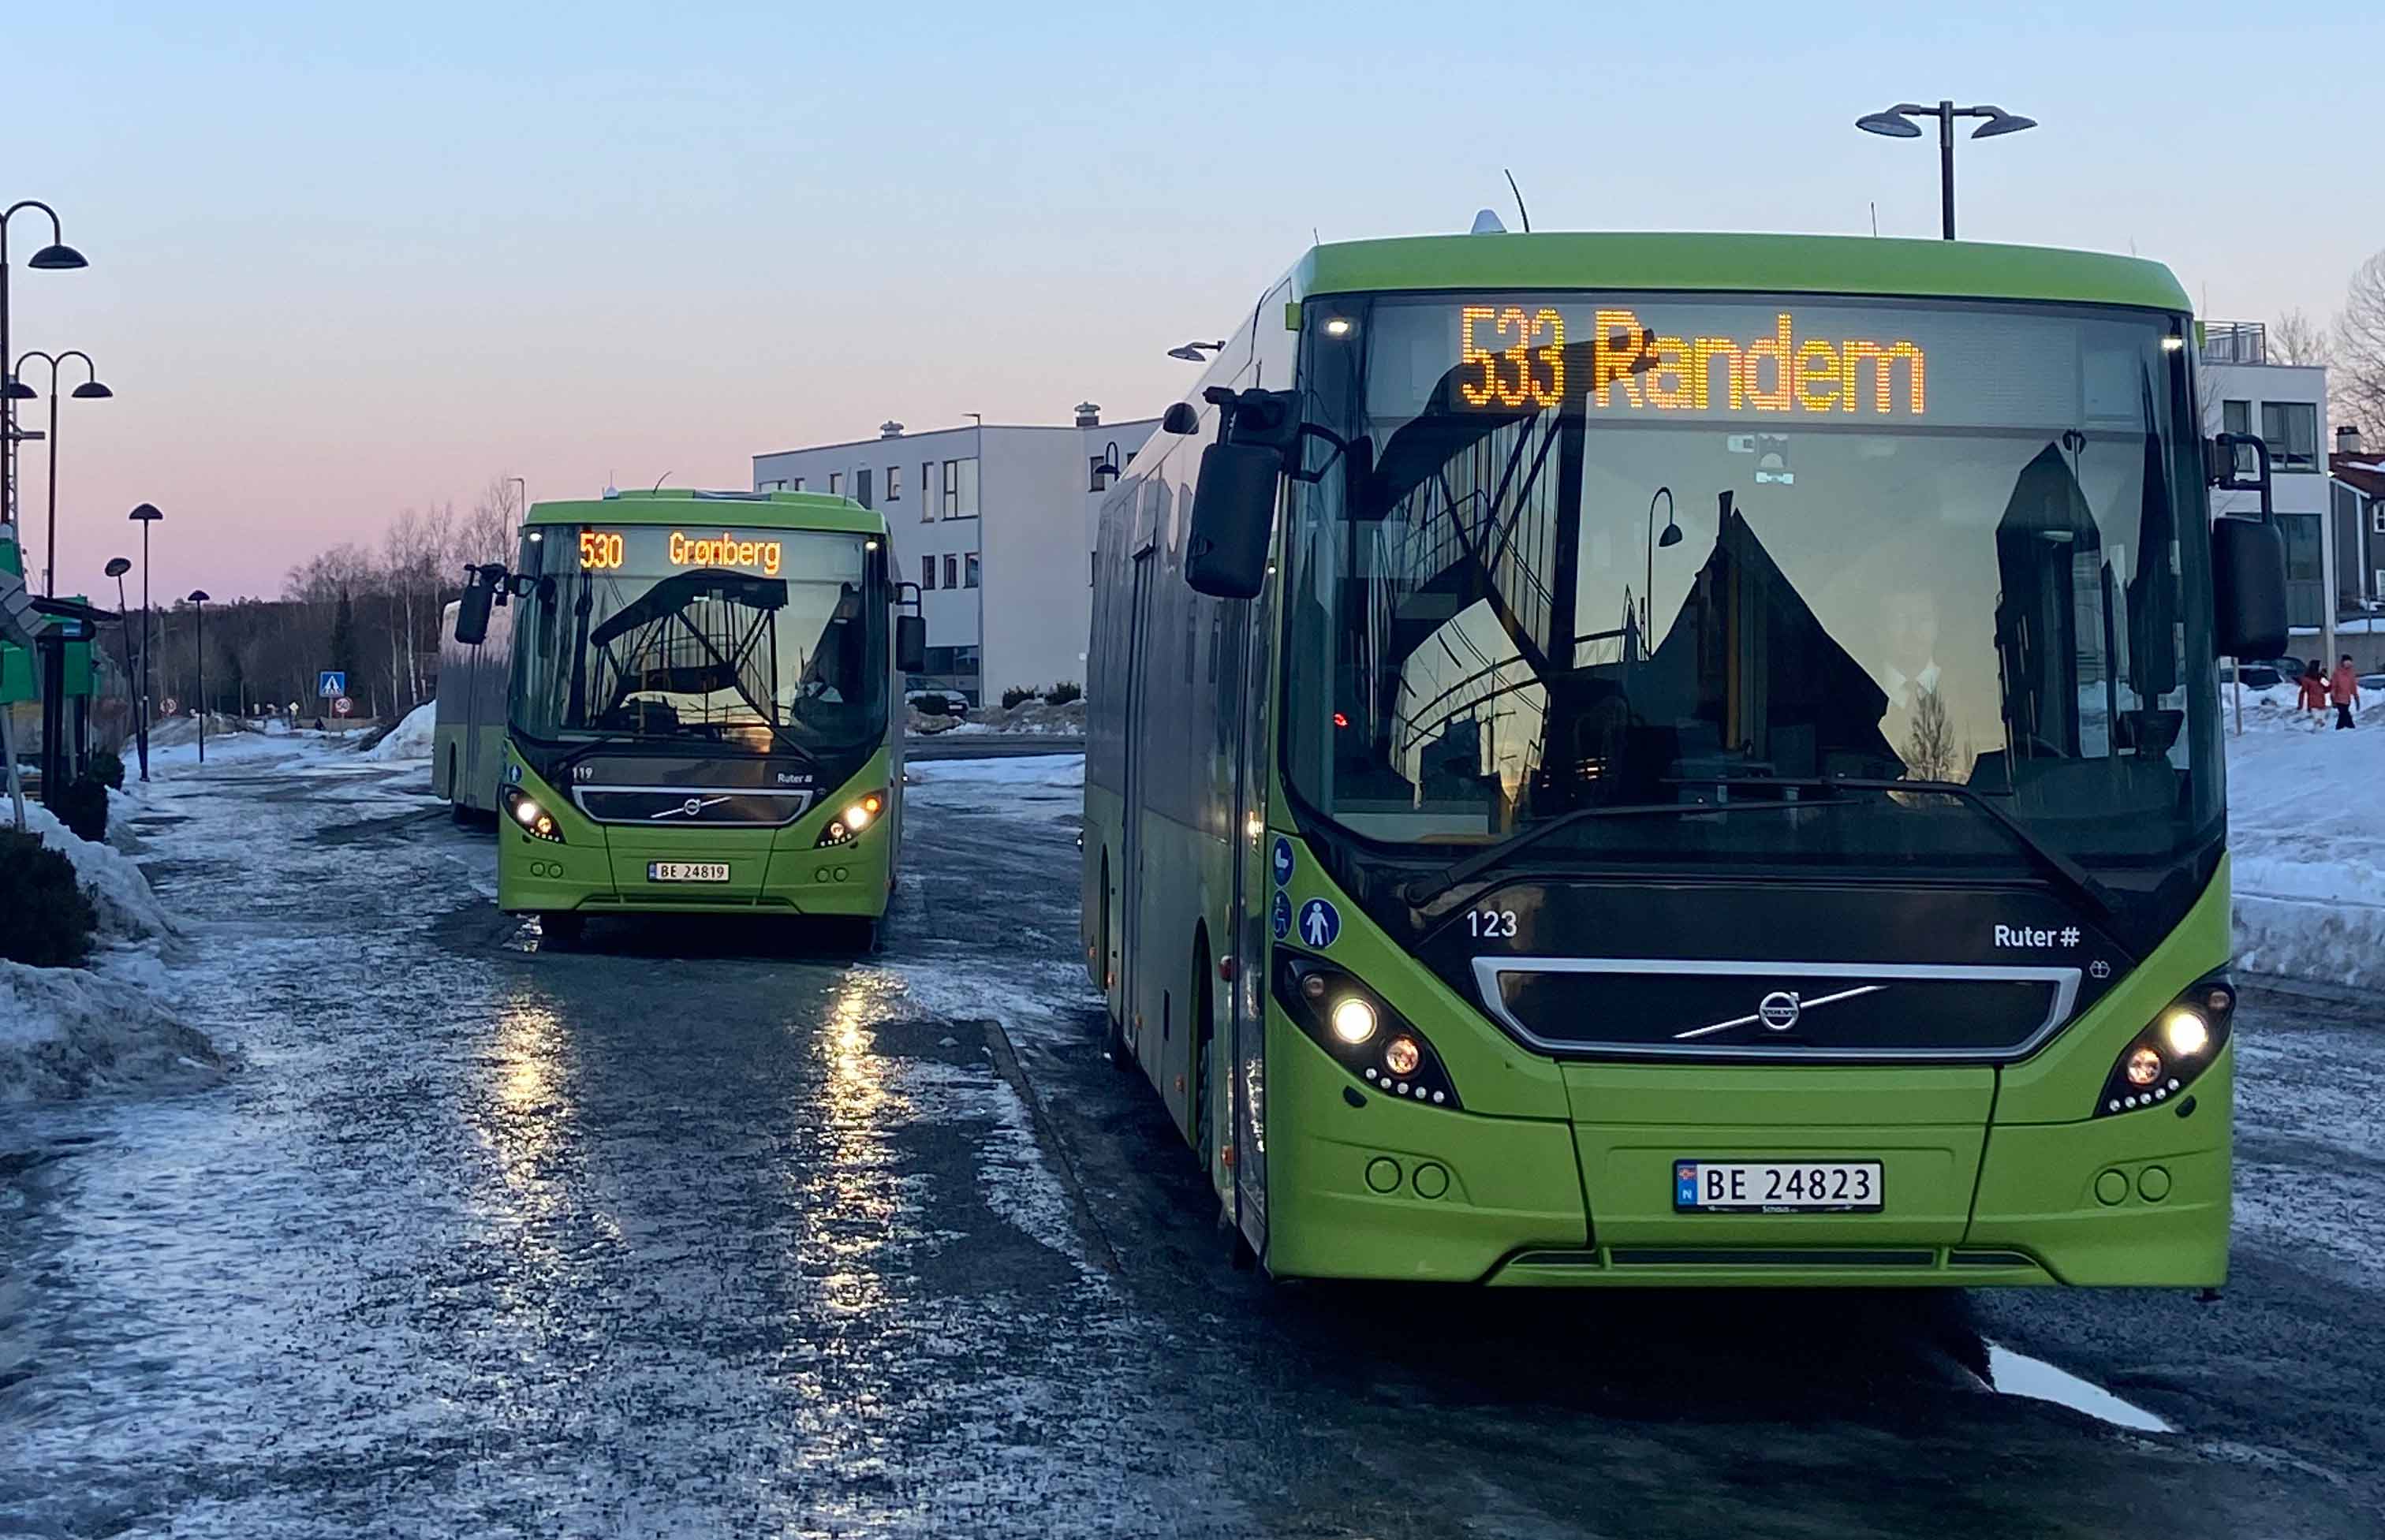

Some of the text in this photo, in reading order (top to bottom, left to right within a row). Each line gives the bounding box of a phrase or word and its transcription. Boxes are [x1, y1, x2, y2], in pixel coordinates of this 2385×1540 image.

[1461, 306, 1924, 414] 533 Randem
[580, 530, 782, 575] 530 Grønberg
[573, 766, 593, 779] 119
[661, 865, 677, 878] BE
[684, 865, 724, 878] 24819
[1467, 910, 1517, 937] 123
[1682, 1189, 1692, 1199] N
[1707, 1169, 1870, 1200] BE 24823
